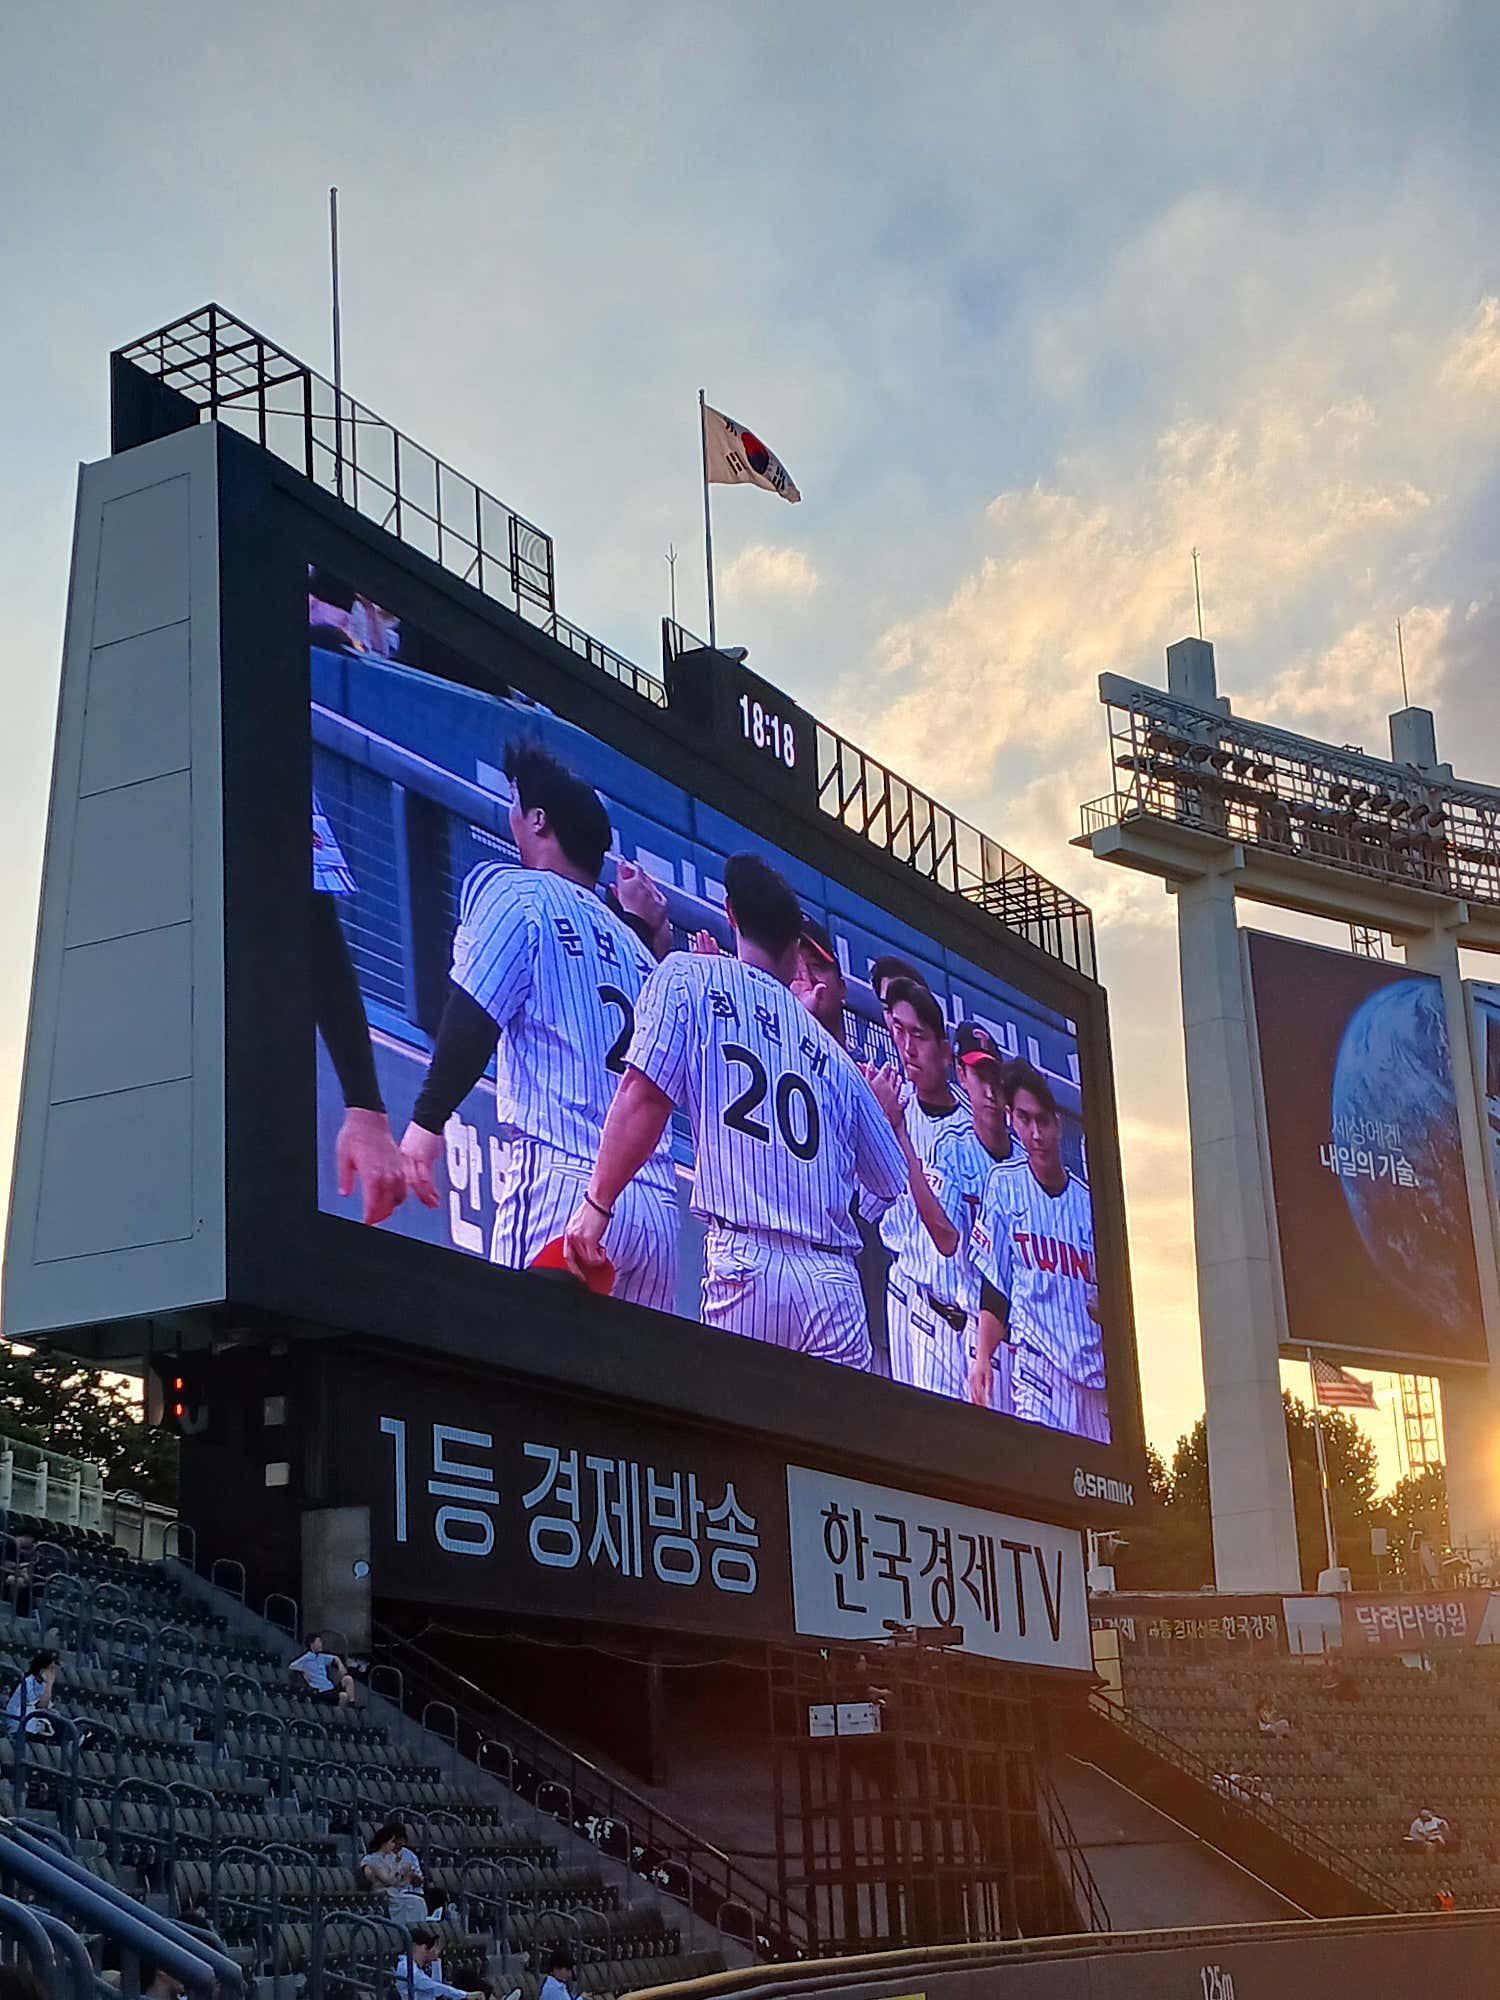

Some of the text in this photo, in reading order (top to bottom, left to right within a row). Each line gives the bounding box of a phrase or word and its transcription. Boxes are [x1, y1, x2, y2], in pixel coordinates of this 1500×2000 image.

[739, 694, 795, 768] 18:18
[708, 989, 829, 1078] 최원태
[720, 1042, 820, 1162] 20
[1332, 1114, 1402, 1152] 세상에겐
[1319, 1143, 1420, 1187] 내일의 기술.
[379, 1416, 760, 1594] 1등 경제방송
[1085, 1473, 1134, 1506] SAMIK
[1201, 1966, 1234, 2000] 125m
